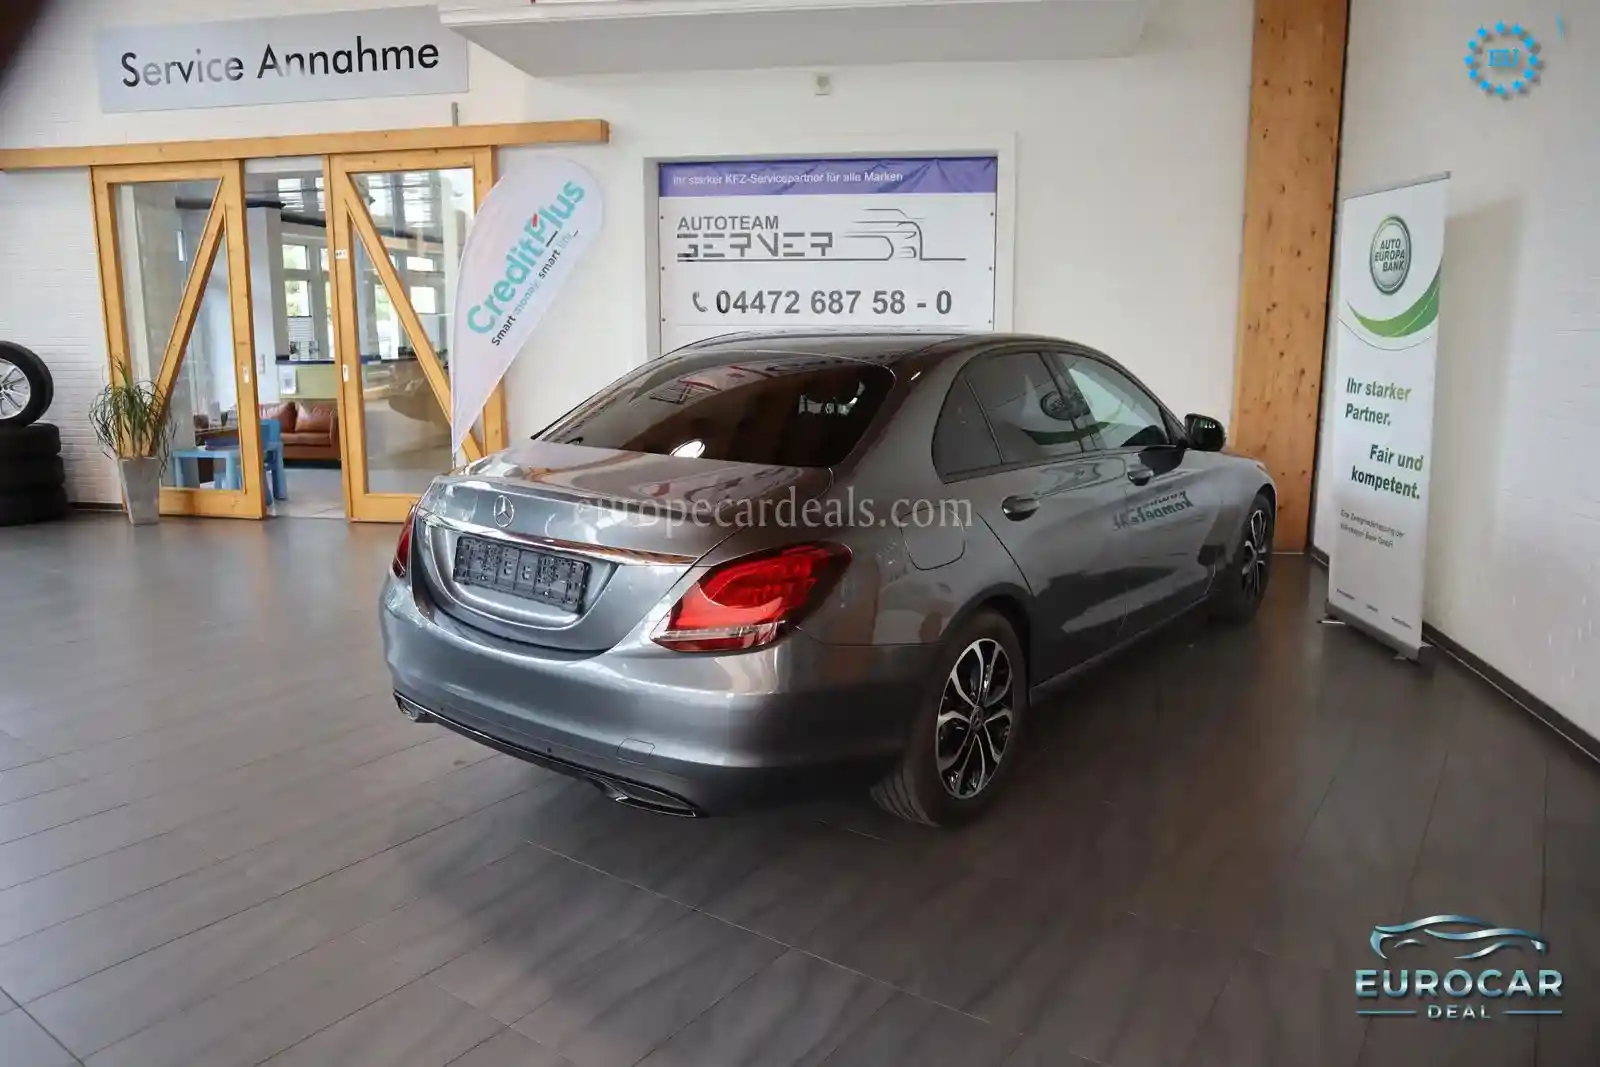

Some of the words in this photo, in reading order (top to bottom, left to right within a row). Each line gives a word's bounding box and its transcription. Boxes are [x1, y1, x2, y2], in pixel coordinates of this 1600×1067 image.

[120, 49, 244, 88] Service
[256, 36, 440, 79] Annahme
[725, 171, 824, 185] KFZ-Servicepartner
[843, 172, 861, 182] alle
[864, 171, 903, 182] Marken
[677, 215, 780, 231] AUTOTEAM
[1374, 248, 1406, 262] EUROPA
[1379, 237, 1401, 250] AUTO
[467, 180, 586, 335] CreditPlus
[1382, 260, 1405, 273] BANK
[491, 314, 517, 347] Smart
[537, 249, 561, 280] smart
[715, 290, 801, 315] 04472
[810, 290, 862, 315] 687
[872, 290, 906, 315] 58
[936, 290, 953, 315] 0
[1346, 377, 1362, 395] Ihr
[1364, 380, 1412, 402] starker
[1345, 403, 1391, 426] Partner.
[1370, 443, 1395, 467] Fair
[1397, 453, 1424, 472] und
[1351, 465, 1421, 500] kompetent.
